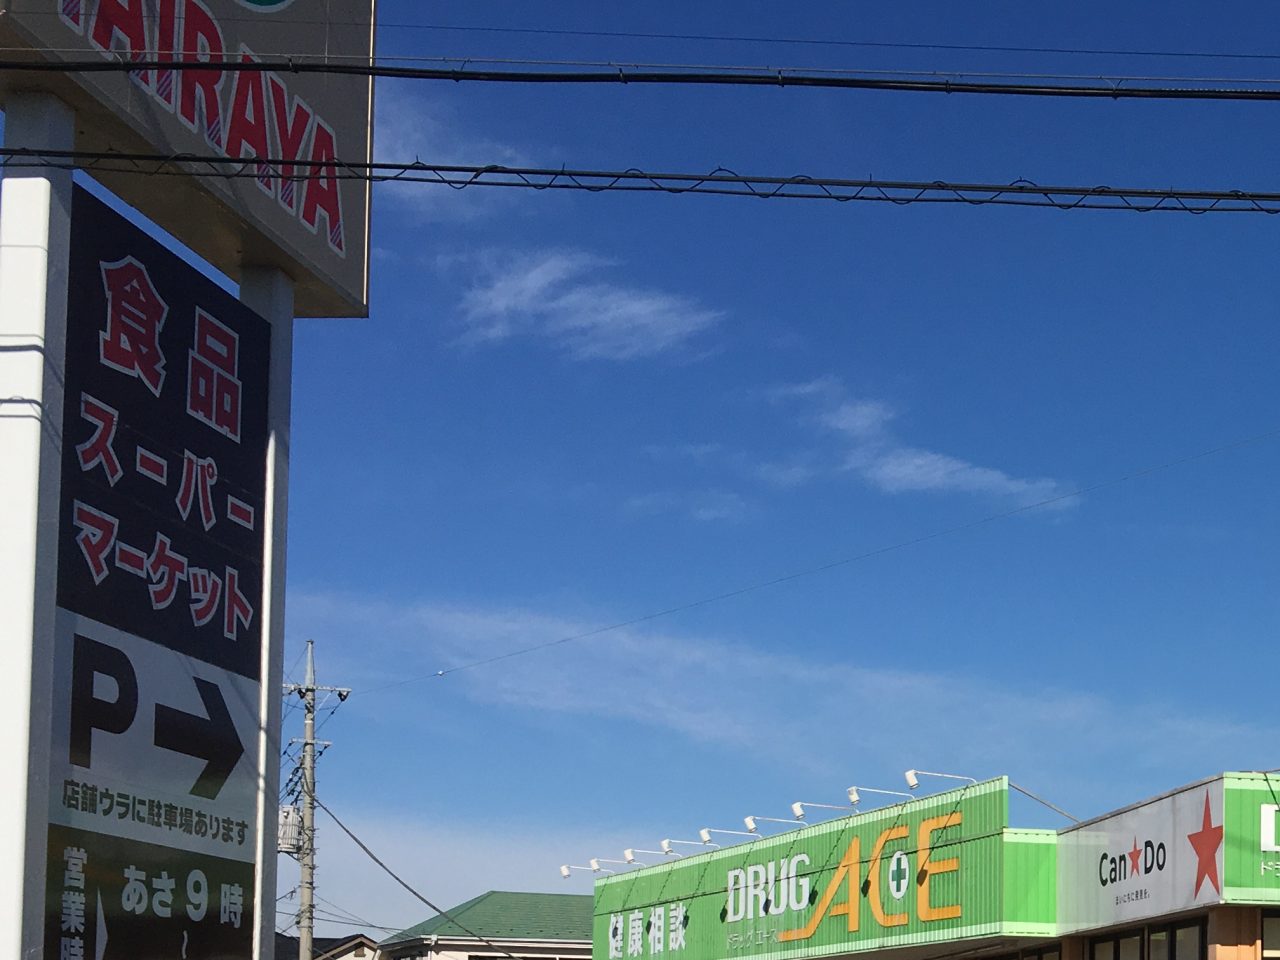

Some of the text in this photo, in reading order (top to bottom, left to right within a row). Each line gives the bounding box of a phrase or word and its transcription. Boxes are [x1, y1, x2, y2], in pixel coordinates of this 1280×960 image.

[58, 0, 345, 258] AIRAYA
[99, 255, 242, 444] 食品
[75, 391, 255, 532] スーパー
[73, 499, 254, 642] マーケット
[69, 633, 139, 769] P
[62, 779, 249, 845] 店舗ウラに駐車場あります
[727, 811, 963, 942] DRUG ACE
[121, 864, 244, 929] あさ9時
